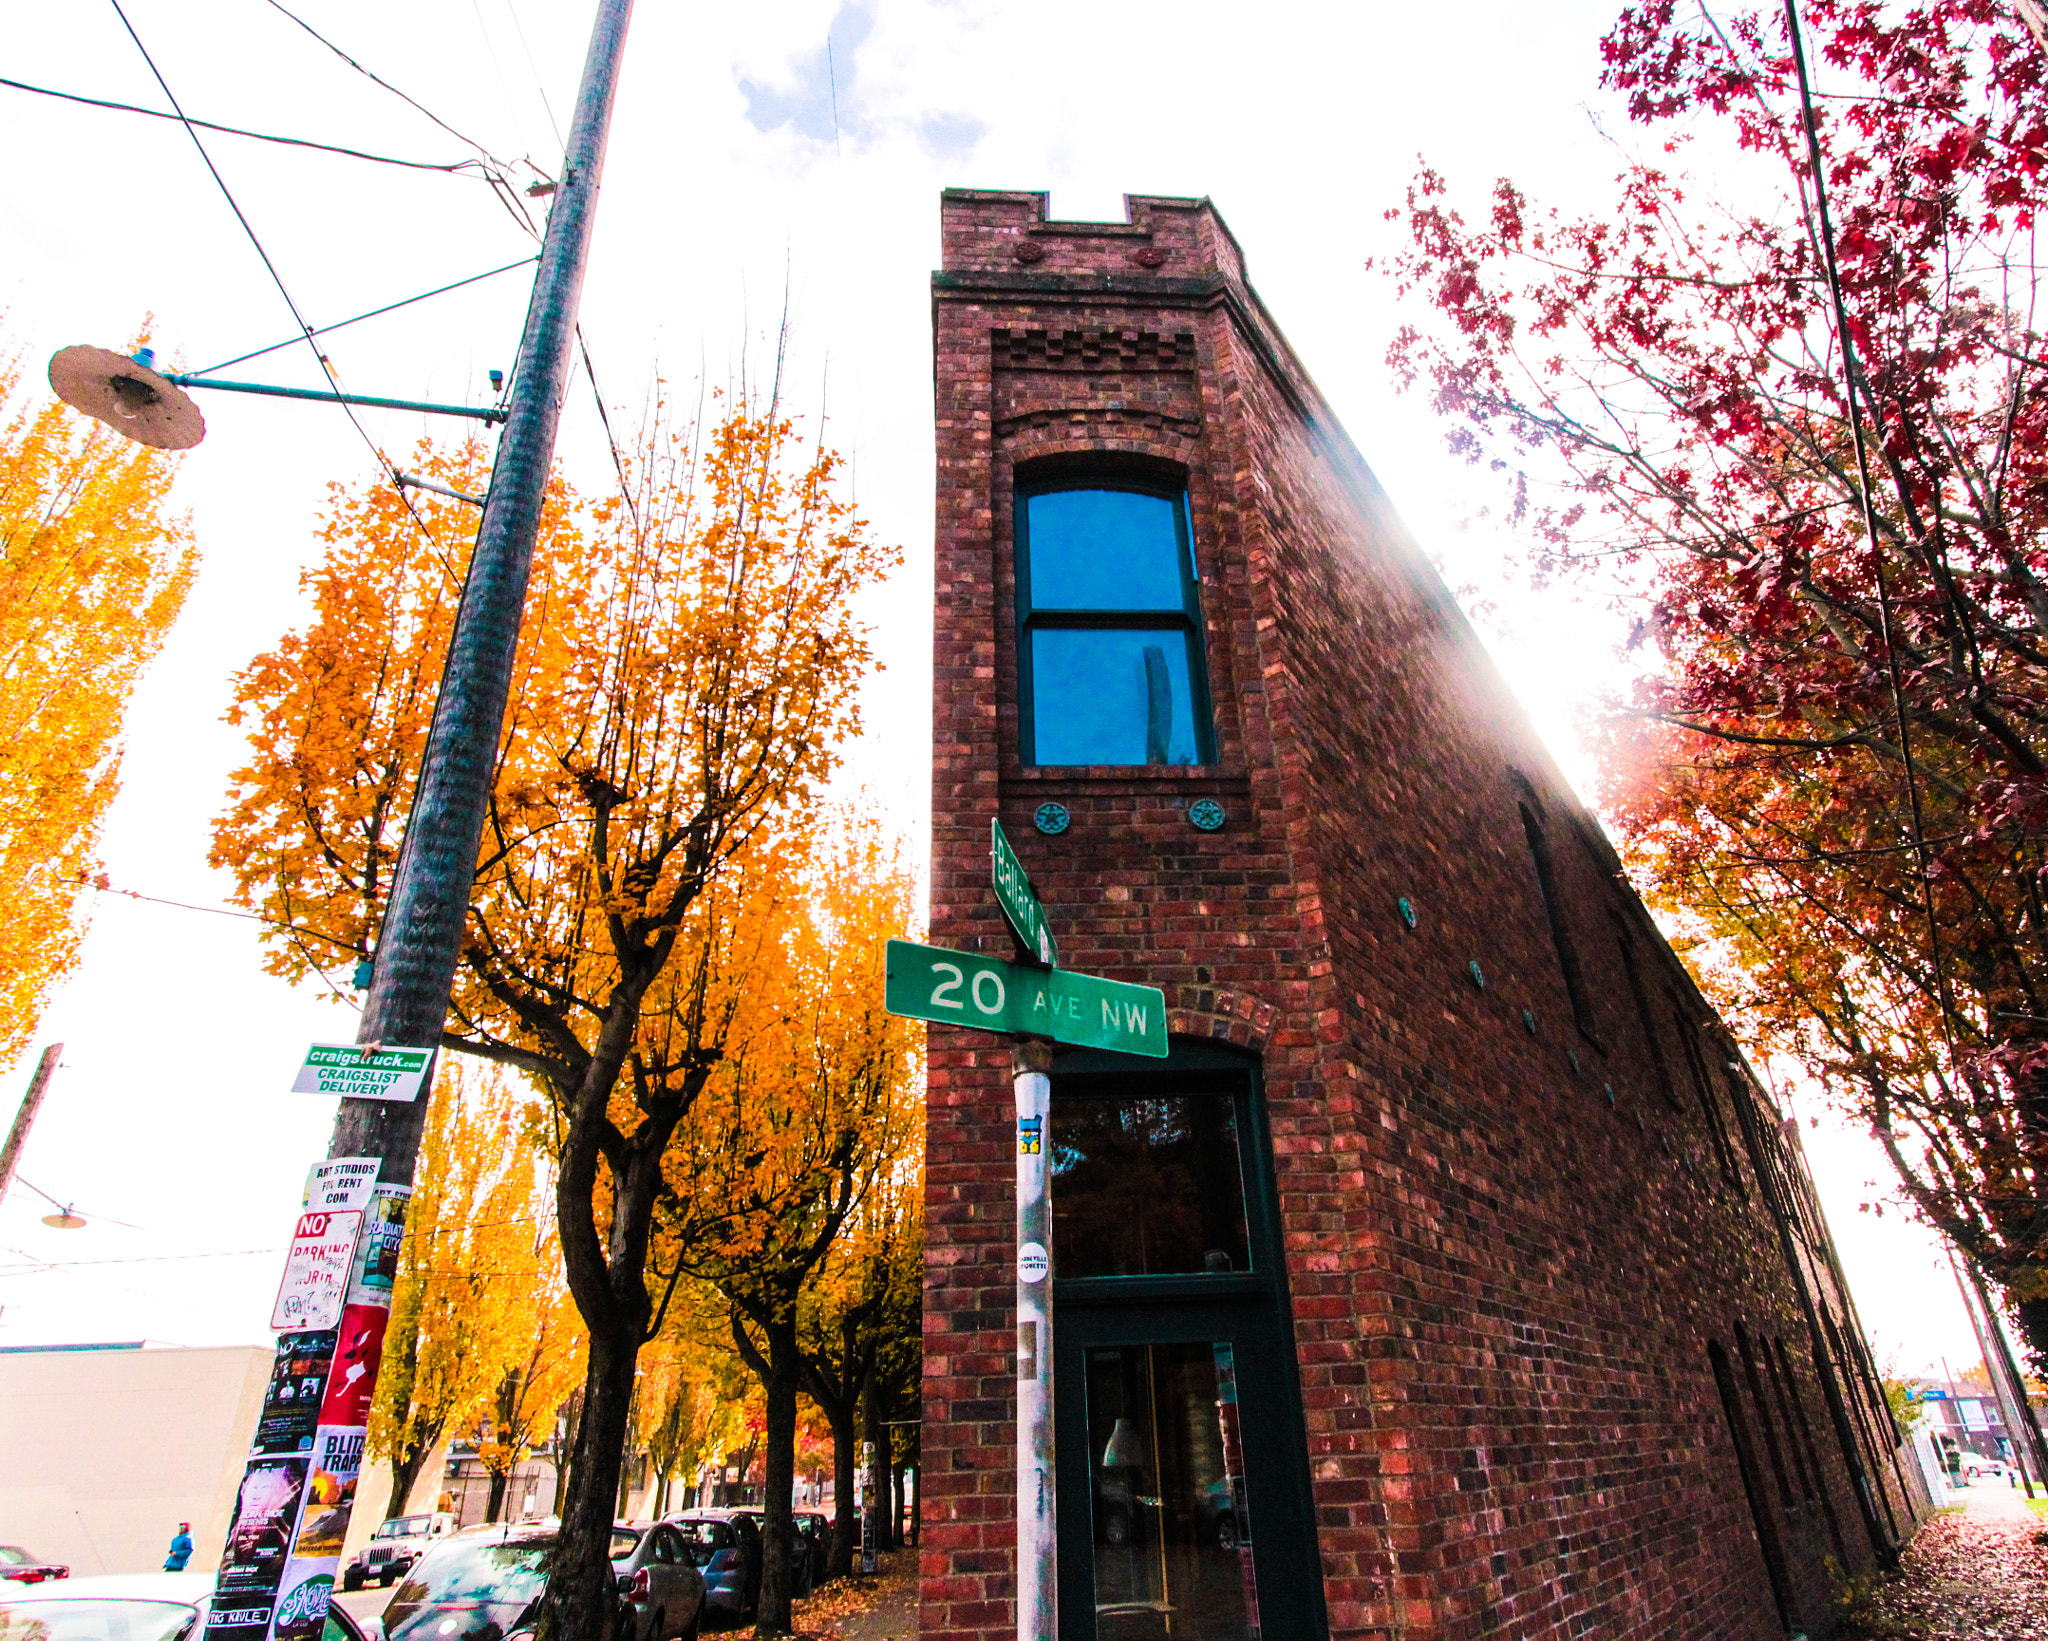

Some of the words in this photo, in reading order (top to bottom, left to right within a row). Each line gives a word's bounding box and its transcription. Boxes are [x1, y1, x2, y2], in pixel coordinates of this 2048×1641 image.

[998, 837, 1034, 937] Ballard
[930, 962, 1006, 1015] 20
[1032, 990, 1082, 1021] AVE
[1101, 997, 1148, 1037] NW
[317, 1068, 402, 1084] CRAIGSLIST
[318, 1081, 389, 1096] DELIVERY
[316, 1166, 333, 1178] ART
[334, 1164, 376, 1175] STUDIOS
[337, 1178, 363, 1188] RENT
[326, 1193, 350, 1204] COM
[298, 1215, 325, 1235] NO
[370, 1221, 404, 1237] RADIAT
